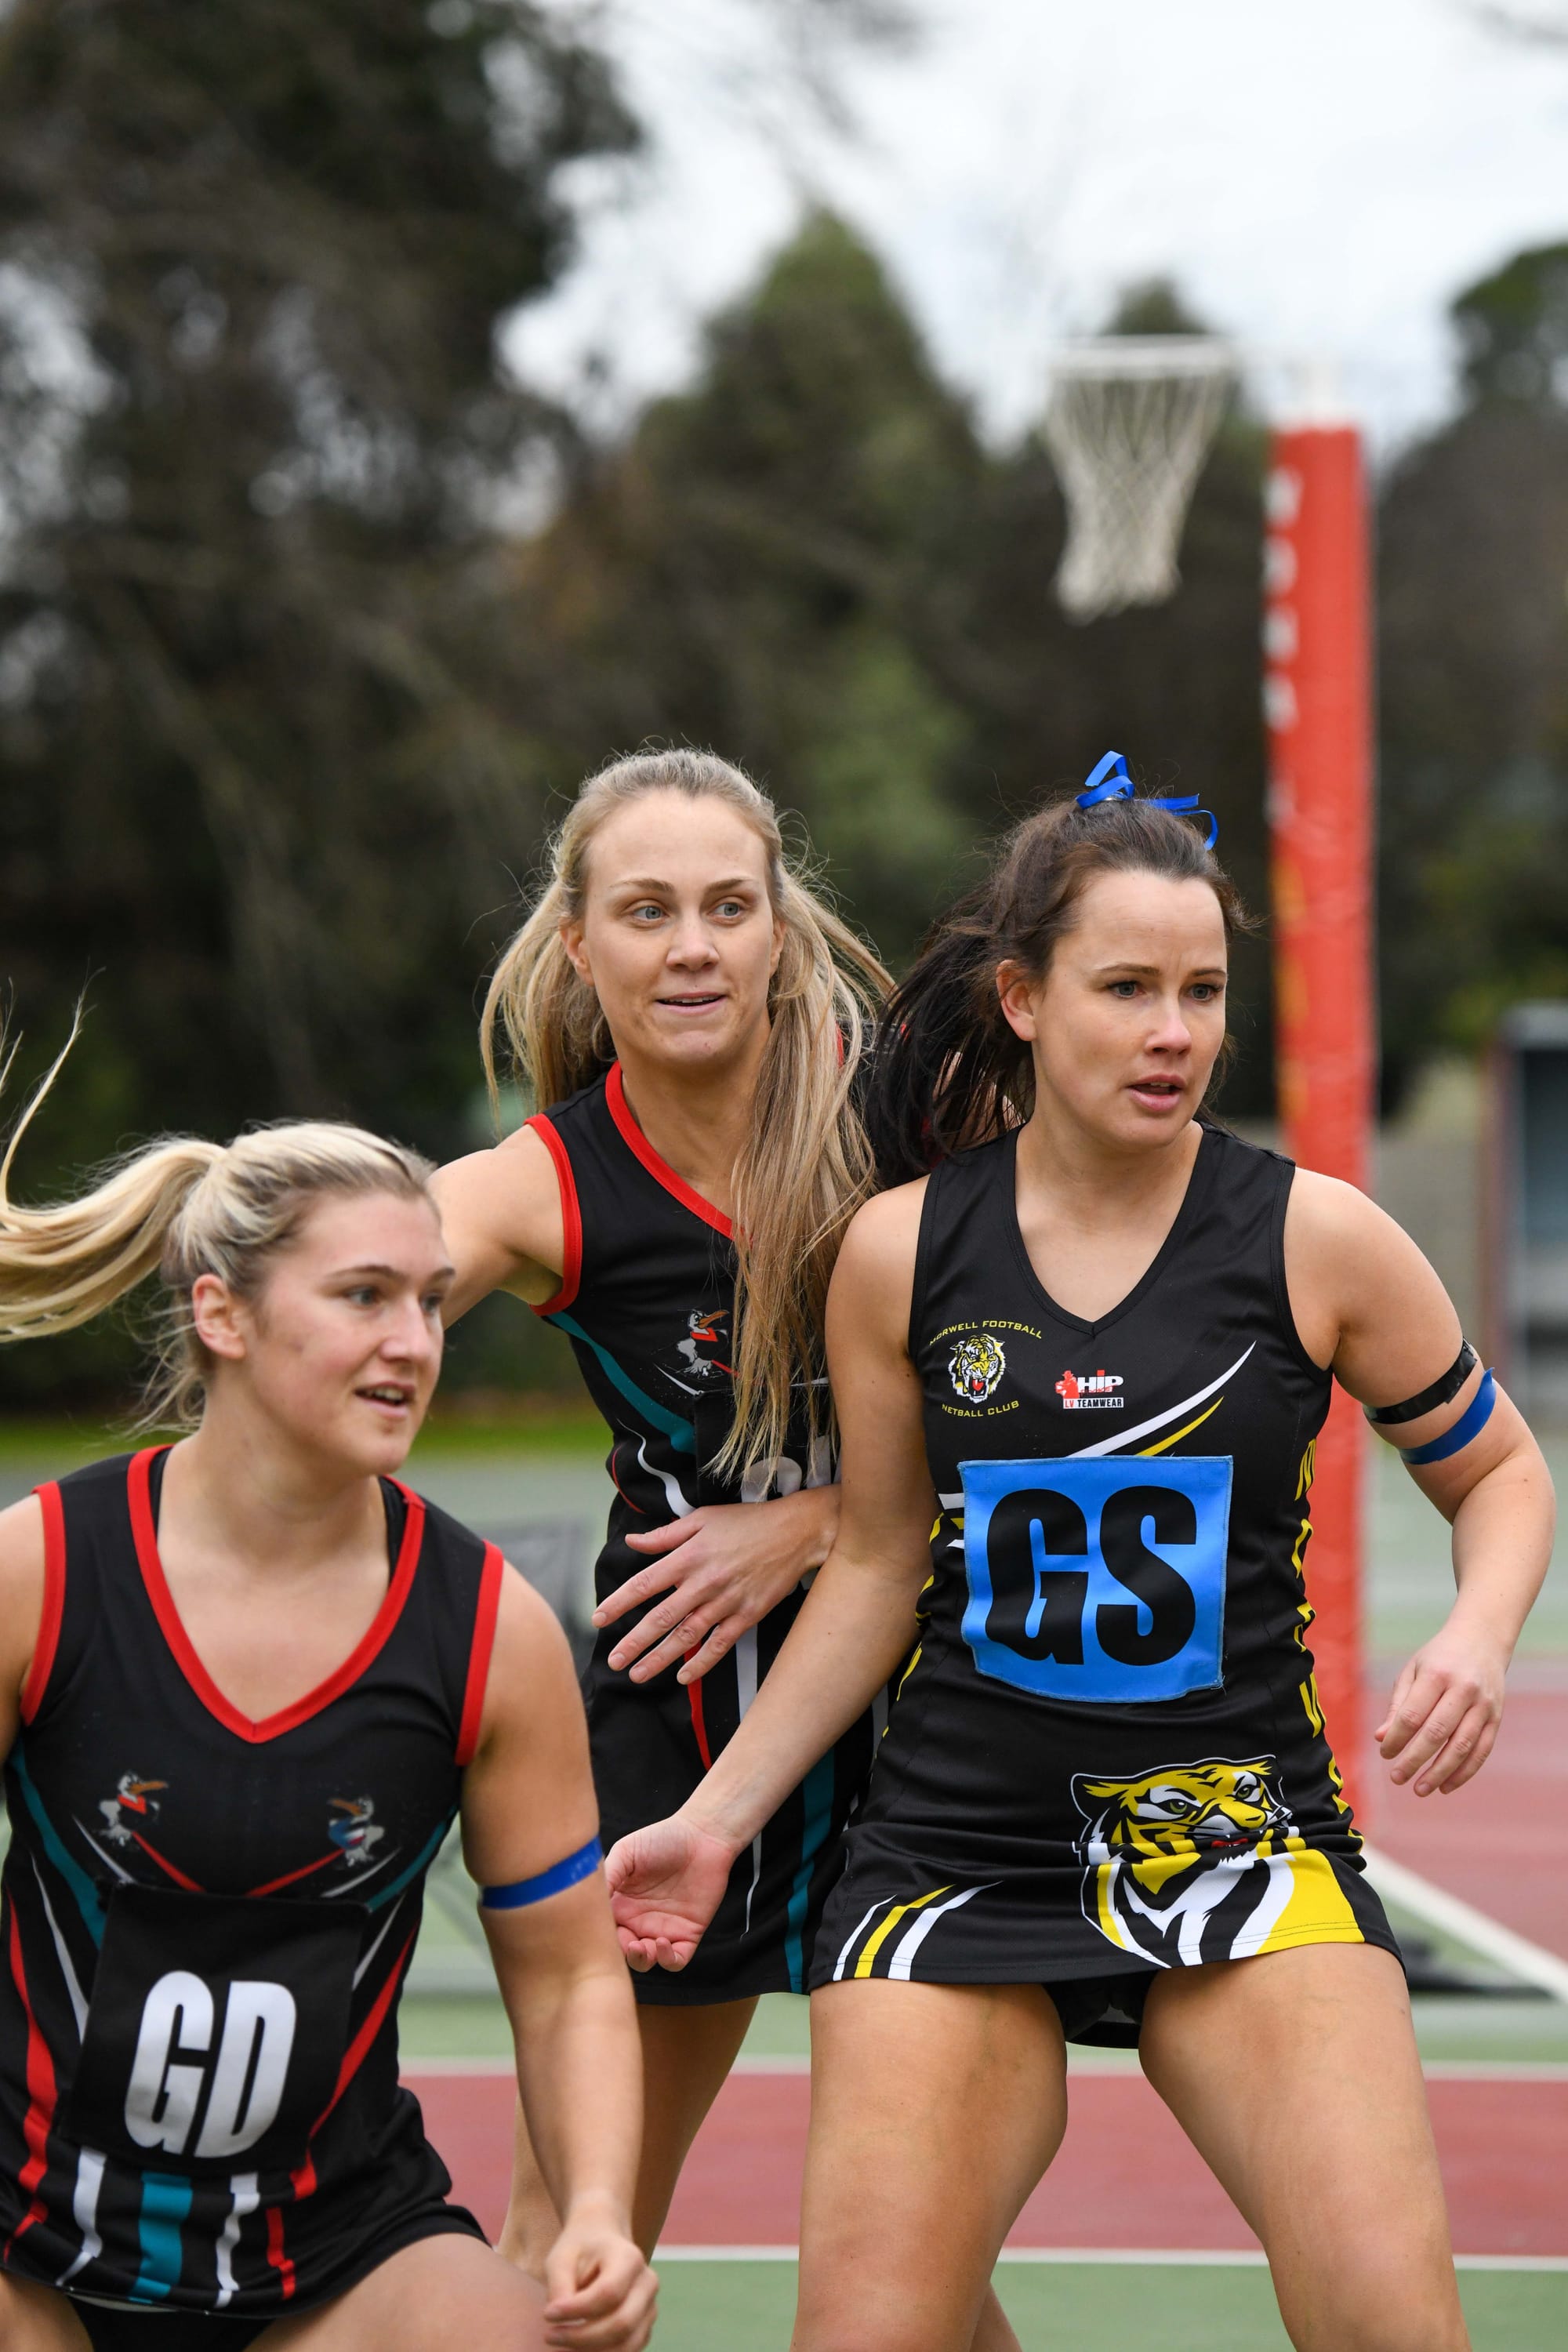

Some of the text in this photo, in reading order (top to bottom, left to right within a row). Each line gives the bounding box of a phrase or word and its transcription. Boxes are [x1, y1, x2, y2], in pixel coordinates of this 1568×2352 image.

[929, 1320, 1042, 1345] MORWELL FOOTBALL
[942, 1400, 1019, 1417] NETBALL CLUB
[1065, 1398, 1122, 1408] LV TEAMWEAR
[985, 1486, 1197, 1666] GS
[125, 1970, 296, 2158] GD
